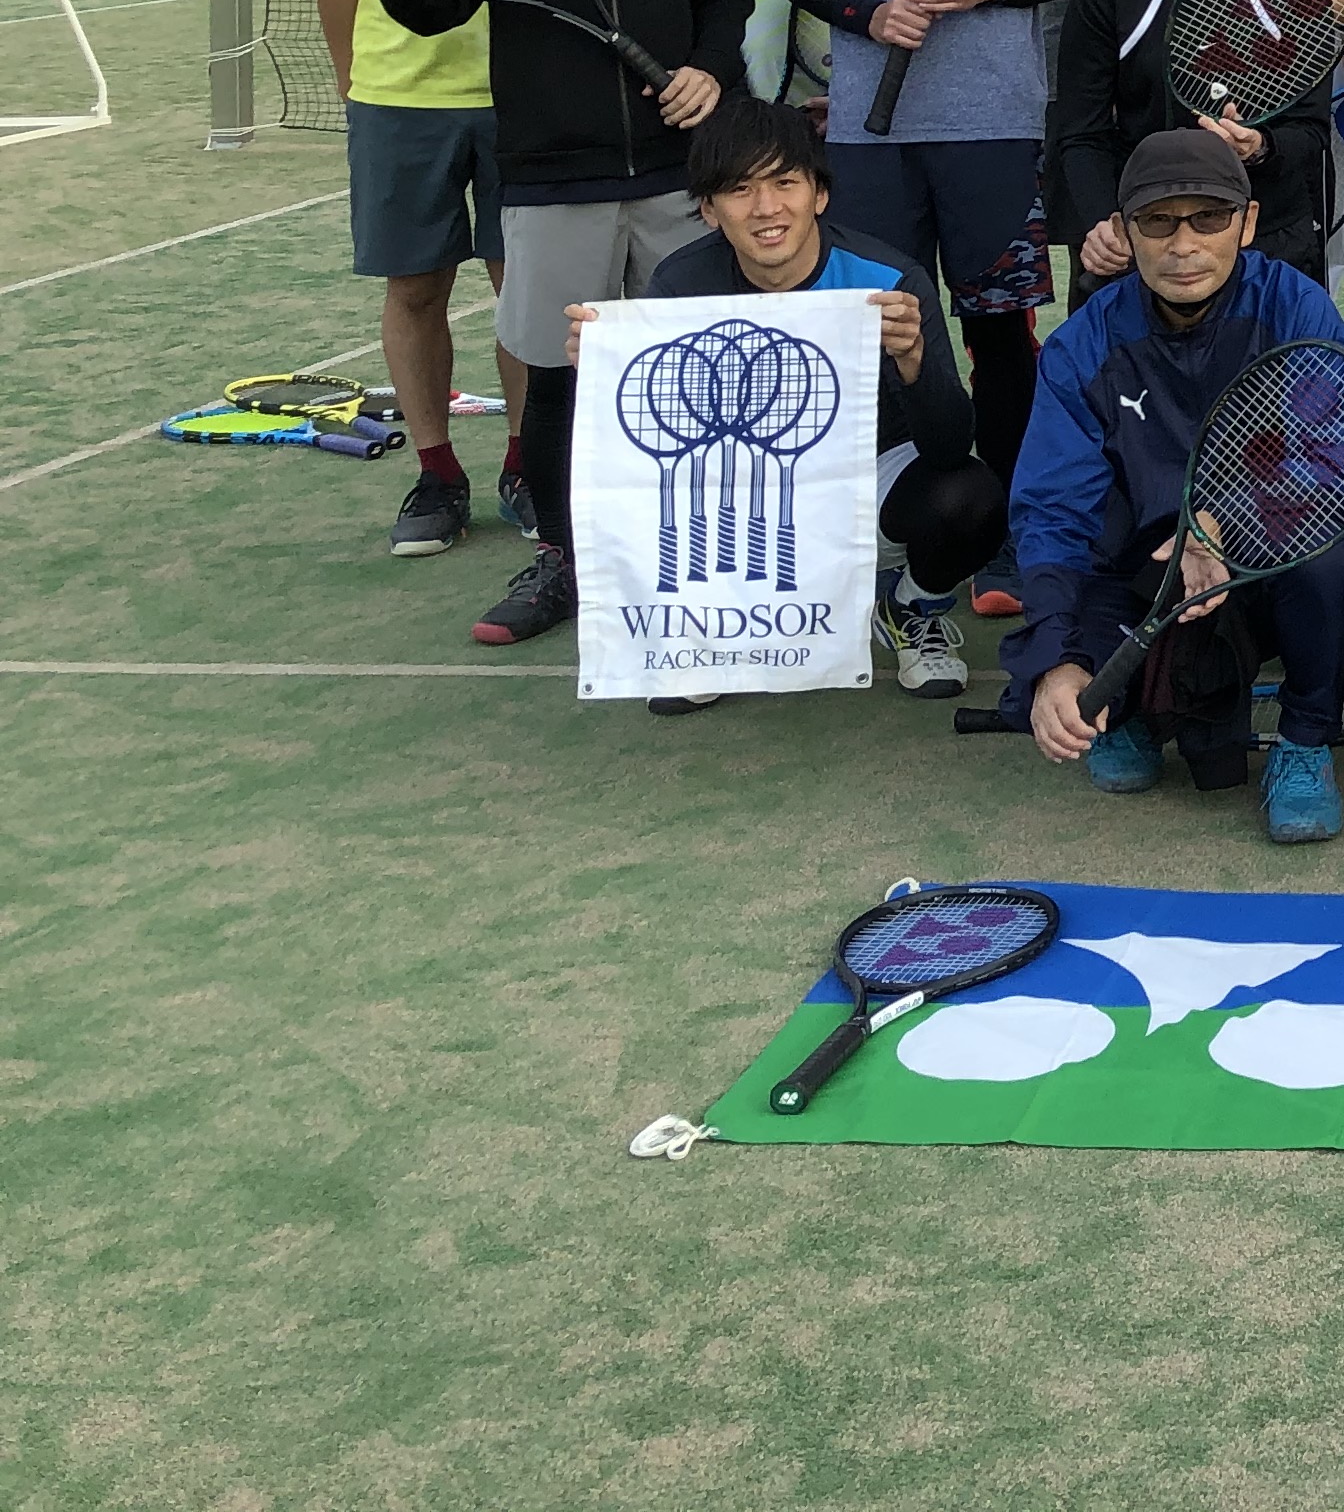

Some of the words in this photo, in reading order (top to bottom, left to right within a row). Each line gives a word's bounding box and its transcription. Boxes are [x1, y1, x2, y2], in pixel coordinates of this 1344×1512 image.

[617, 602, 837, 639] WINDSOR
[643, 648, 743, 670] RACKET
[748, 647, 812, 668] SHOP
